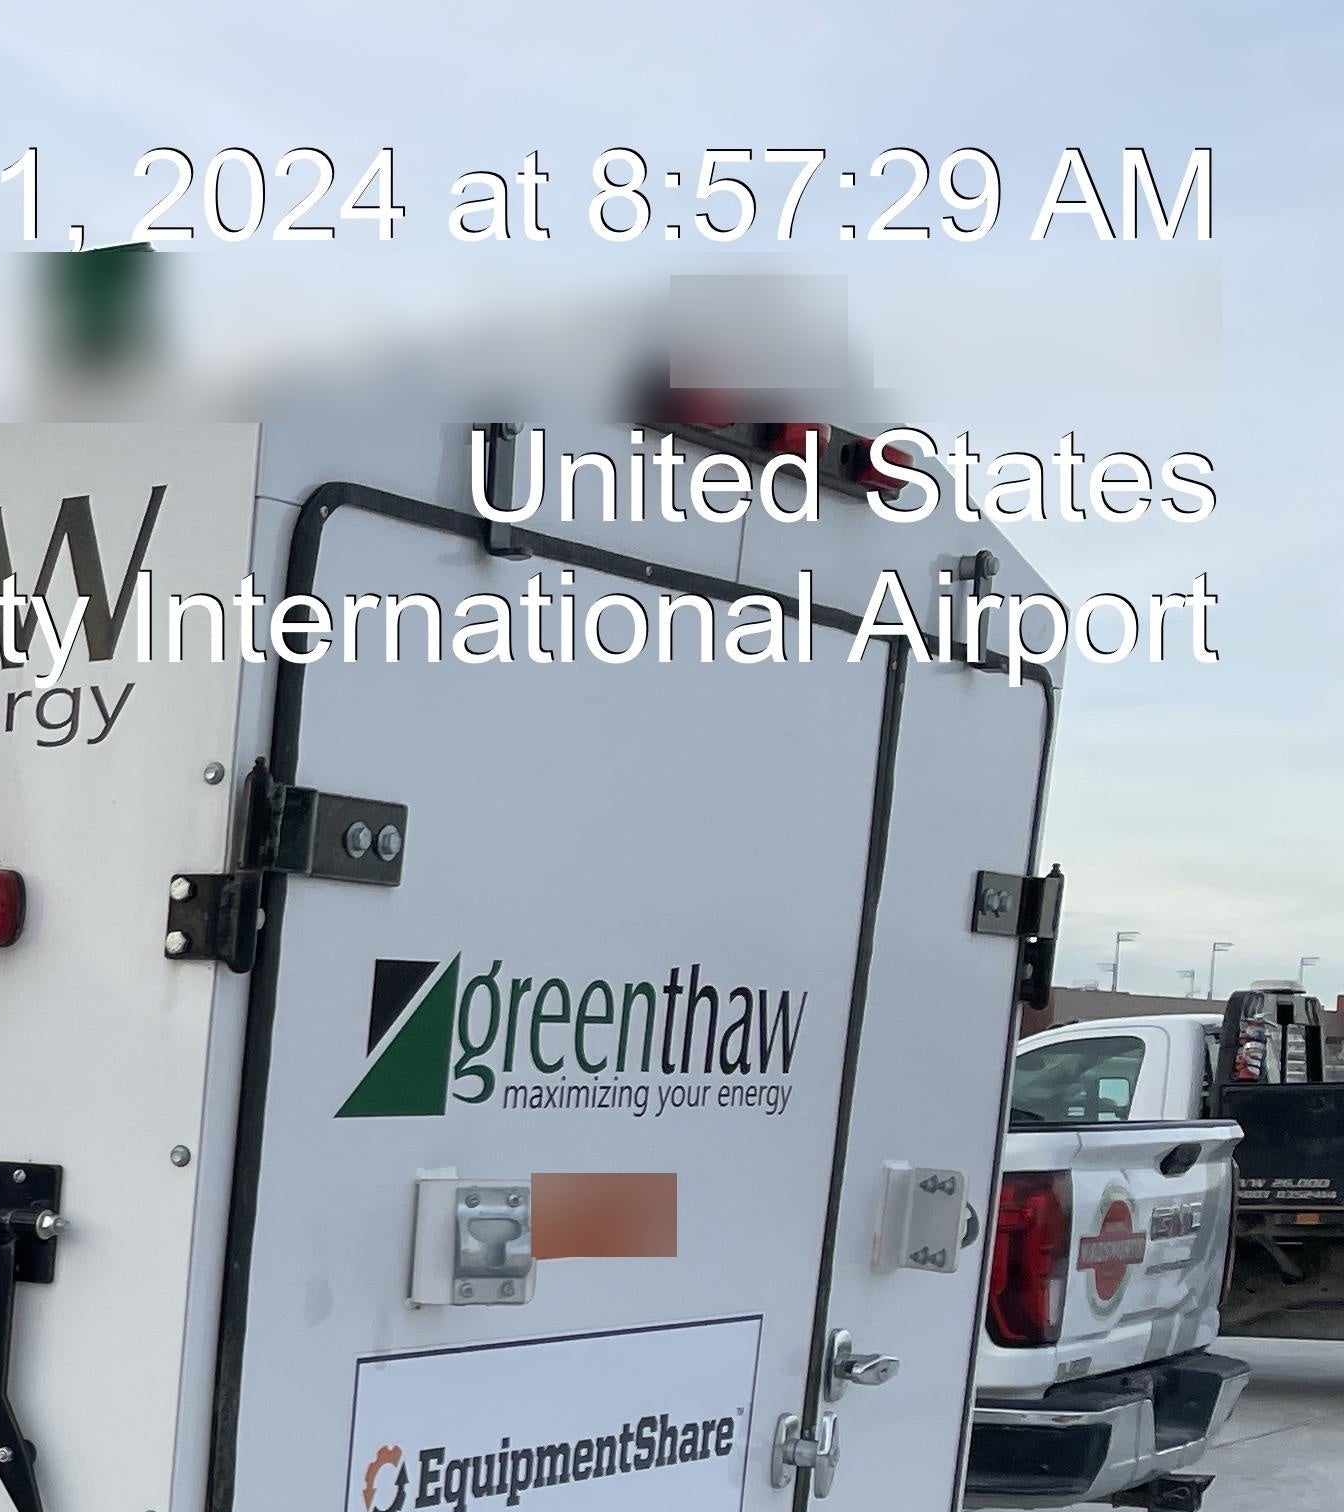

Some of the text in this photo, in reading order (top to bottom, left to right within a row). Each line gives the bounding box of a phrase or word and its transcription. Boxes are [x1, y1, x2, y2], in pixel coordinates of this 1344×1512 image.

[452, 959, 808, 1104] greenthaw
[503, 1075, 793, 1117] maximizing your energy
